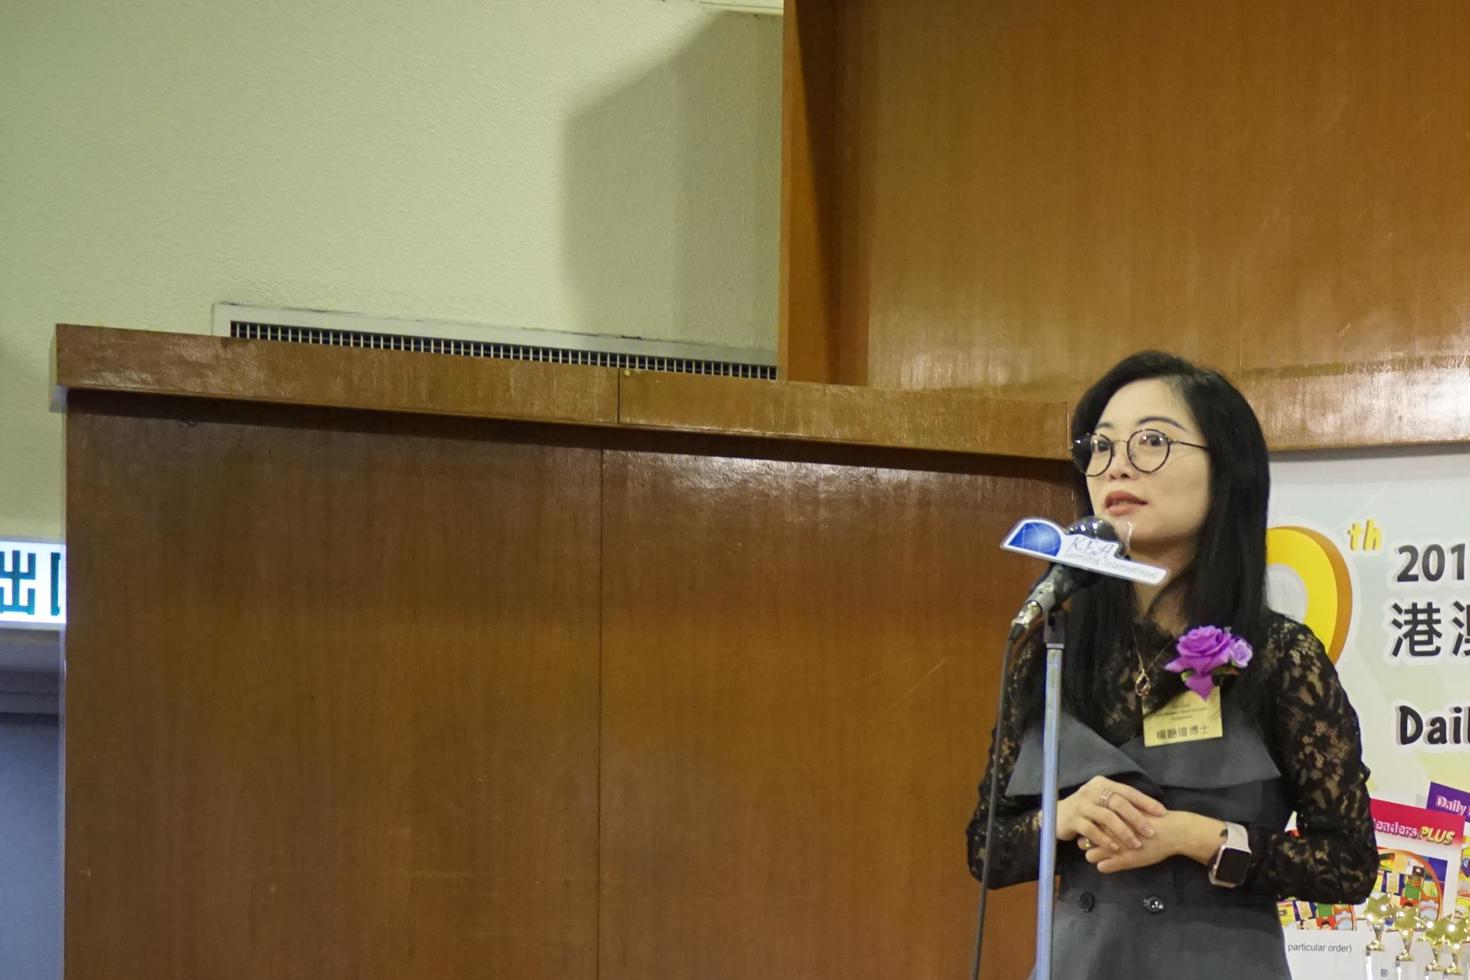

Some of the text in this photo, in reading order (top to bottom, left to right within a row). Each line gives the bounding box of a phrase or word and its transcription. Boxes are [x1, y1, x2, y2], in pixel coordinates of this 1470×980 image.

[1435, 793, 1467, 816] Daily
[1373, 818, 1456, 846] eaders PLUS
[1288, 942, 1326, 952] particular
